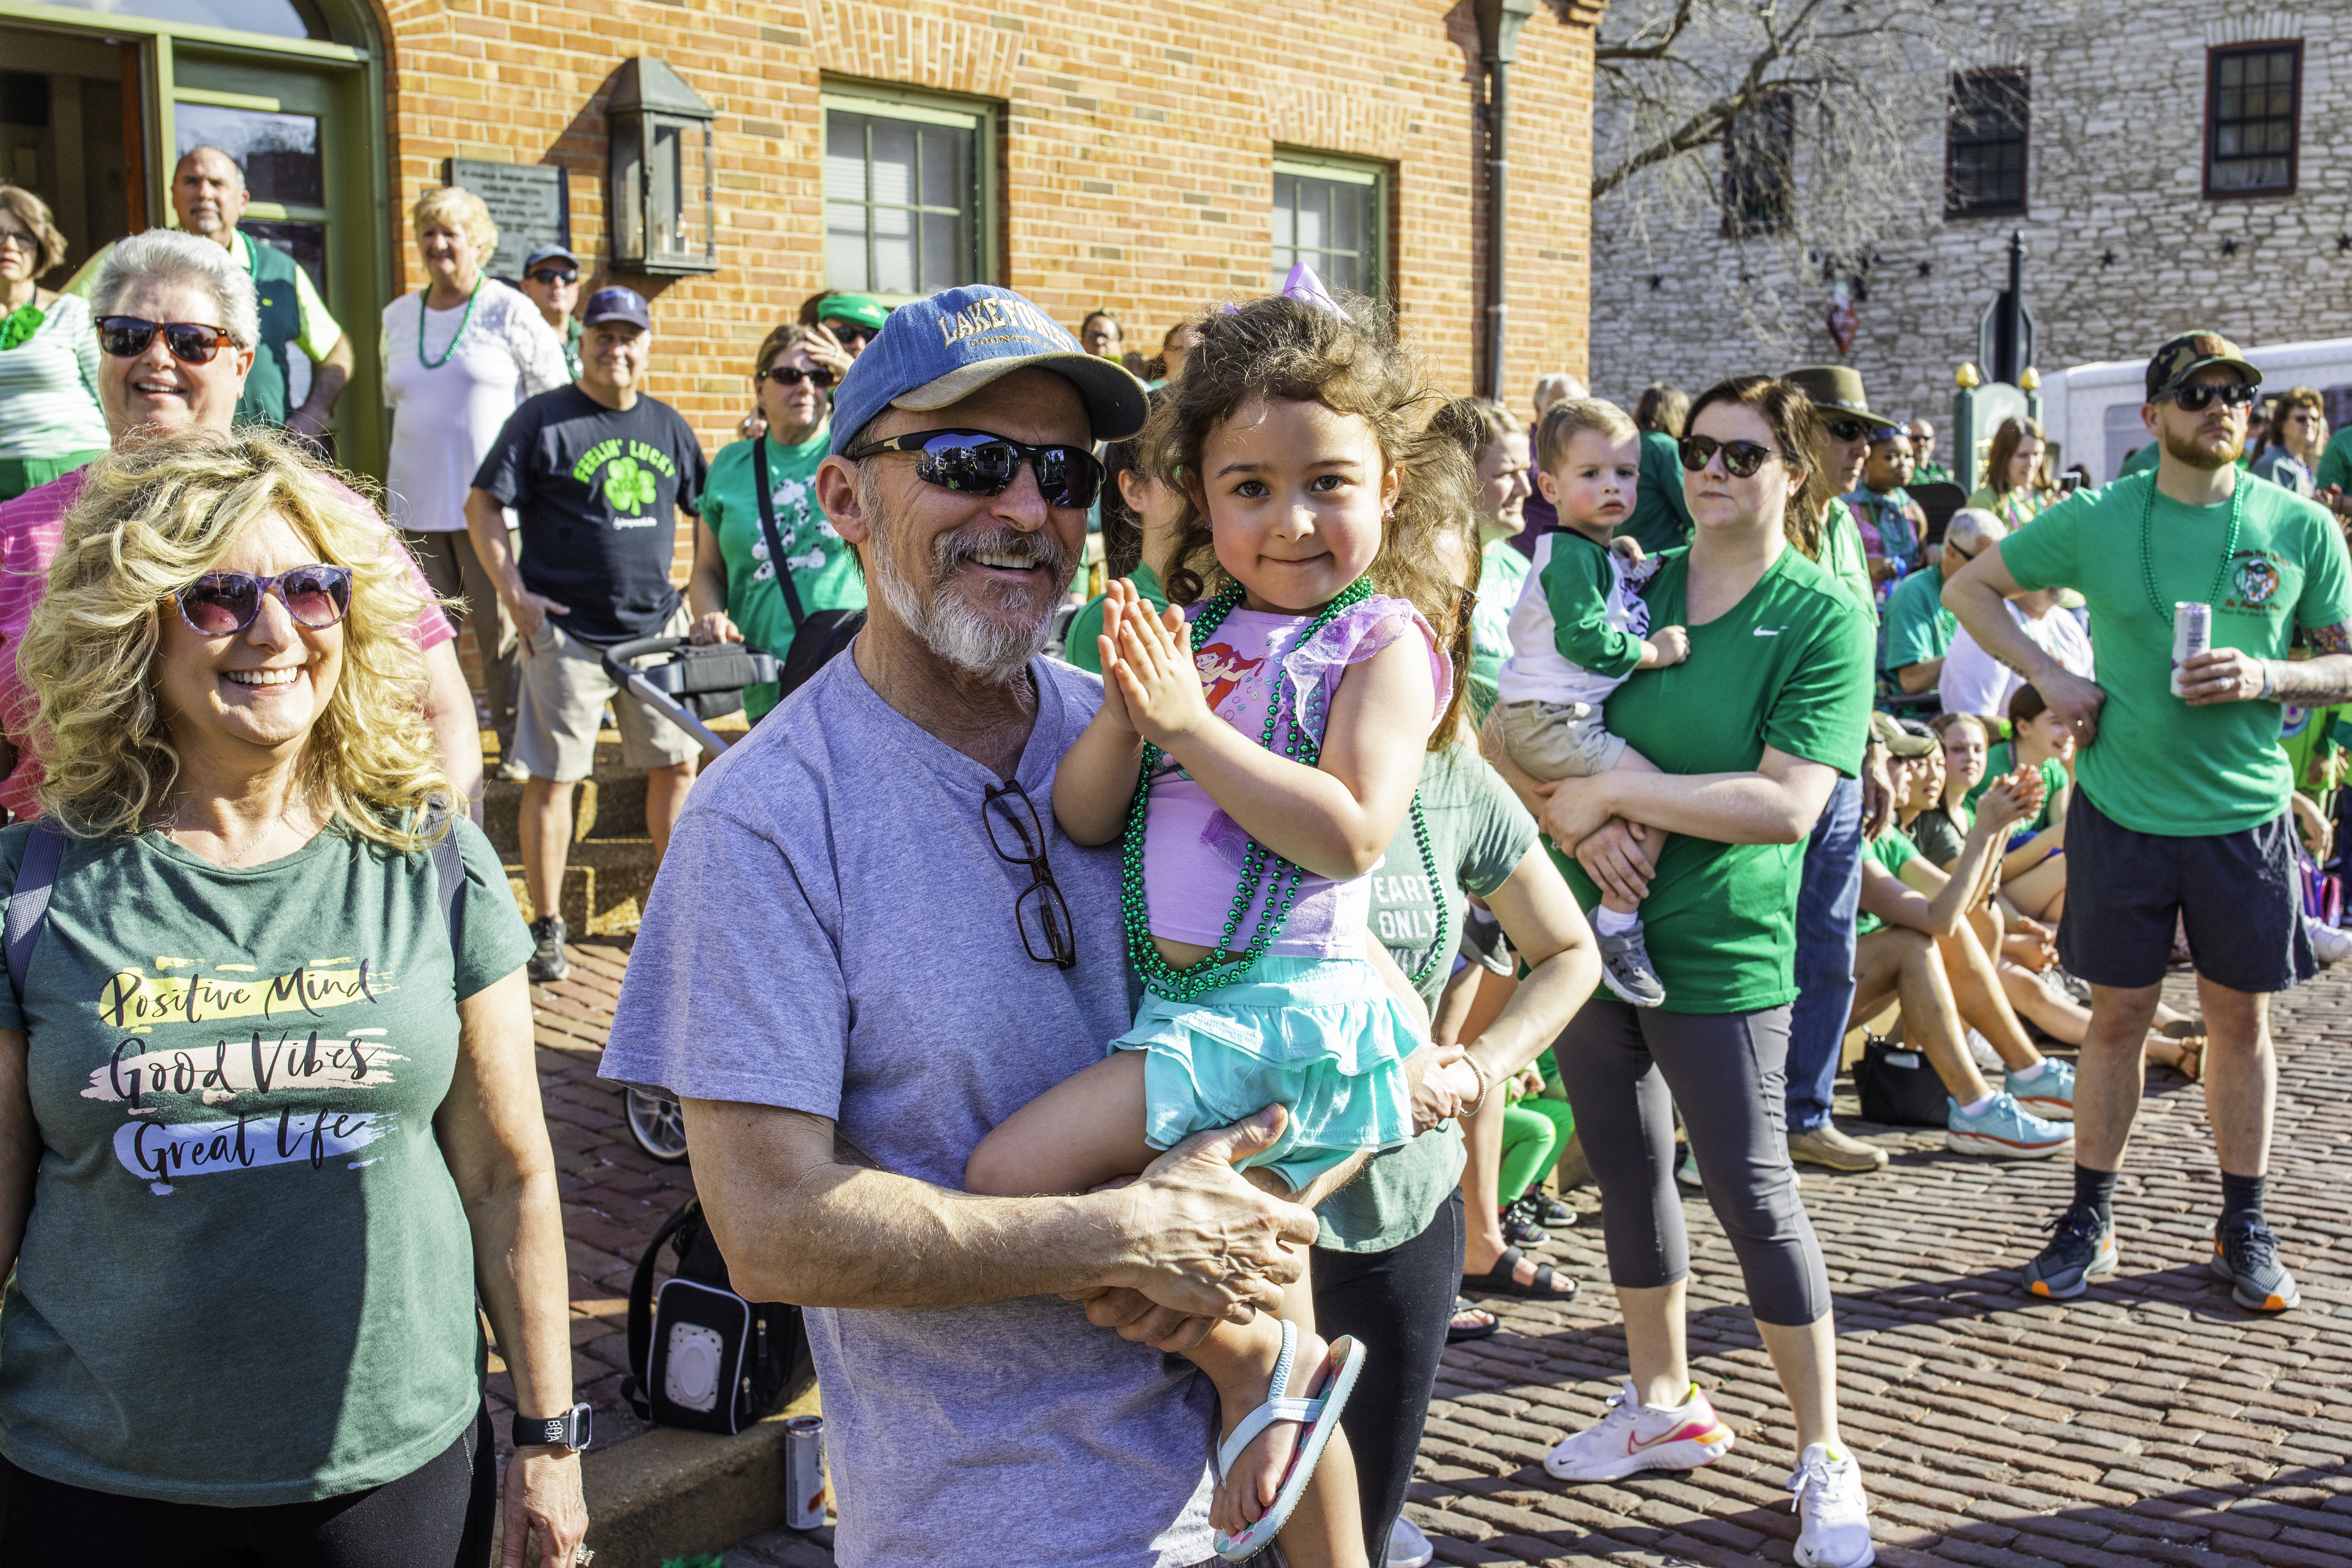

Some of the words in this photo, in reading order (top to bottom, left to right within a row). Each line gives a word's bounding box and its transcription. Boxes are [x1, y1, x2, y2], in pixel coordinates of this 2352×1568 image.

[937, 296, 1008, 349] LAKE
[999, 298, 1077, 353] FOREST
[969, 335, 1039, 347] COUNTRY
[572, 438, 623, 483] FEELIN'
[629, 439, 676, 478] LUCKY
[1378, 910, 1437, 939] ONLY
[100, 972, 250, 1026] Positive
[264, 958, 378, 1021] Mind
[110, 1037, 236, 1109] Good
[251, 1031, 379, 1094] Vibes
[134, 1111, 263, 1184] Great
[277, 1106, 366, 1169] Life
